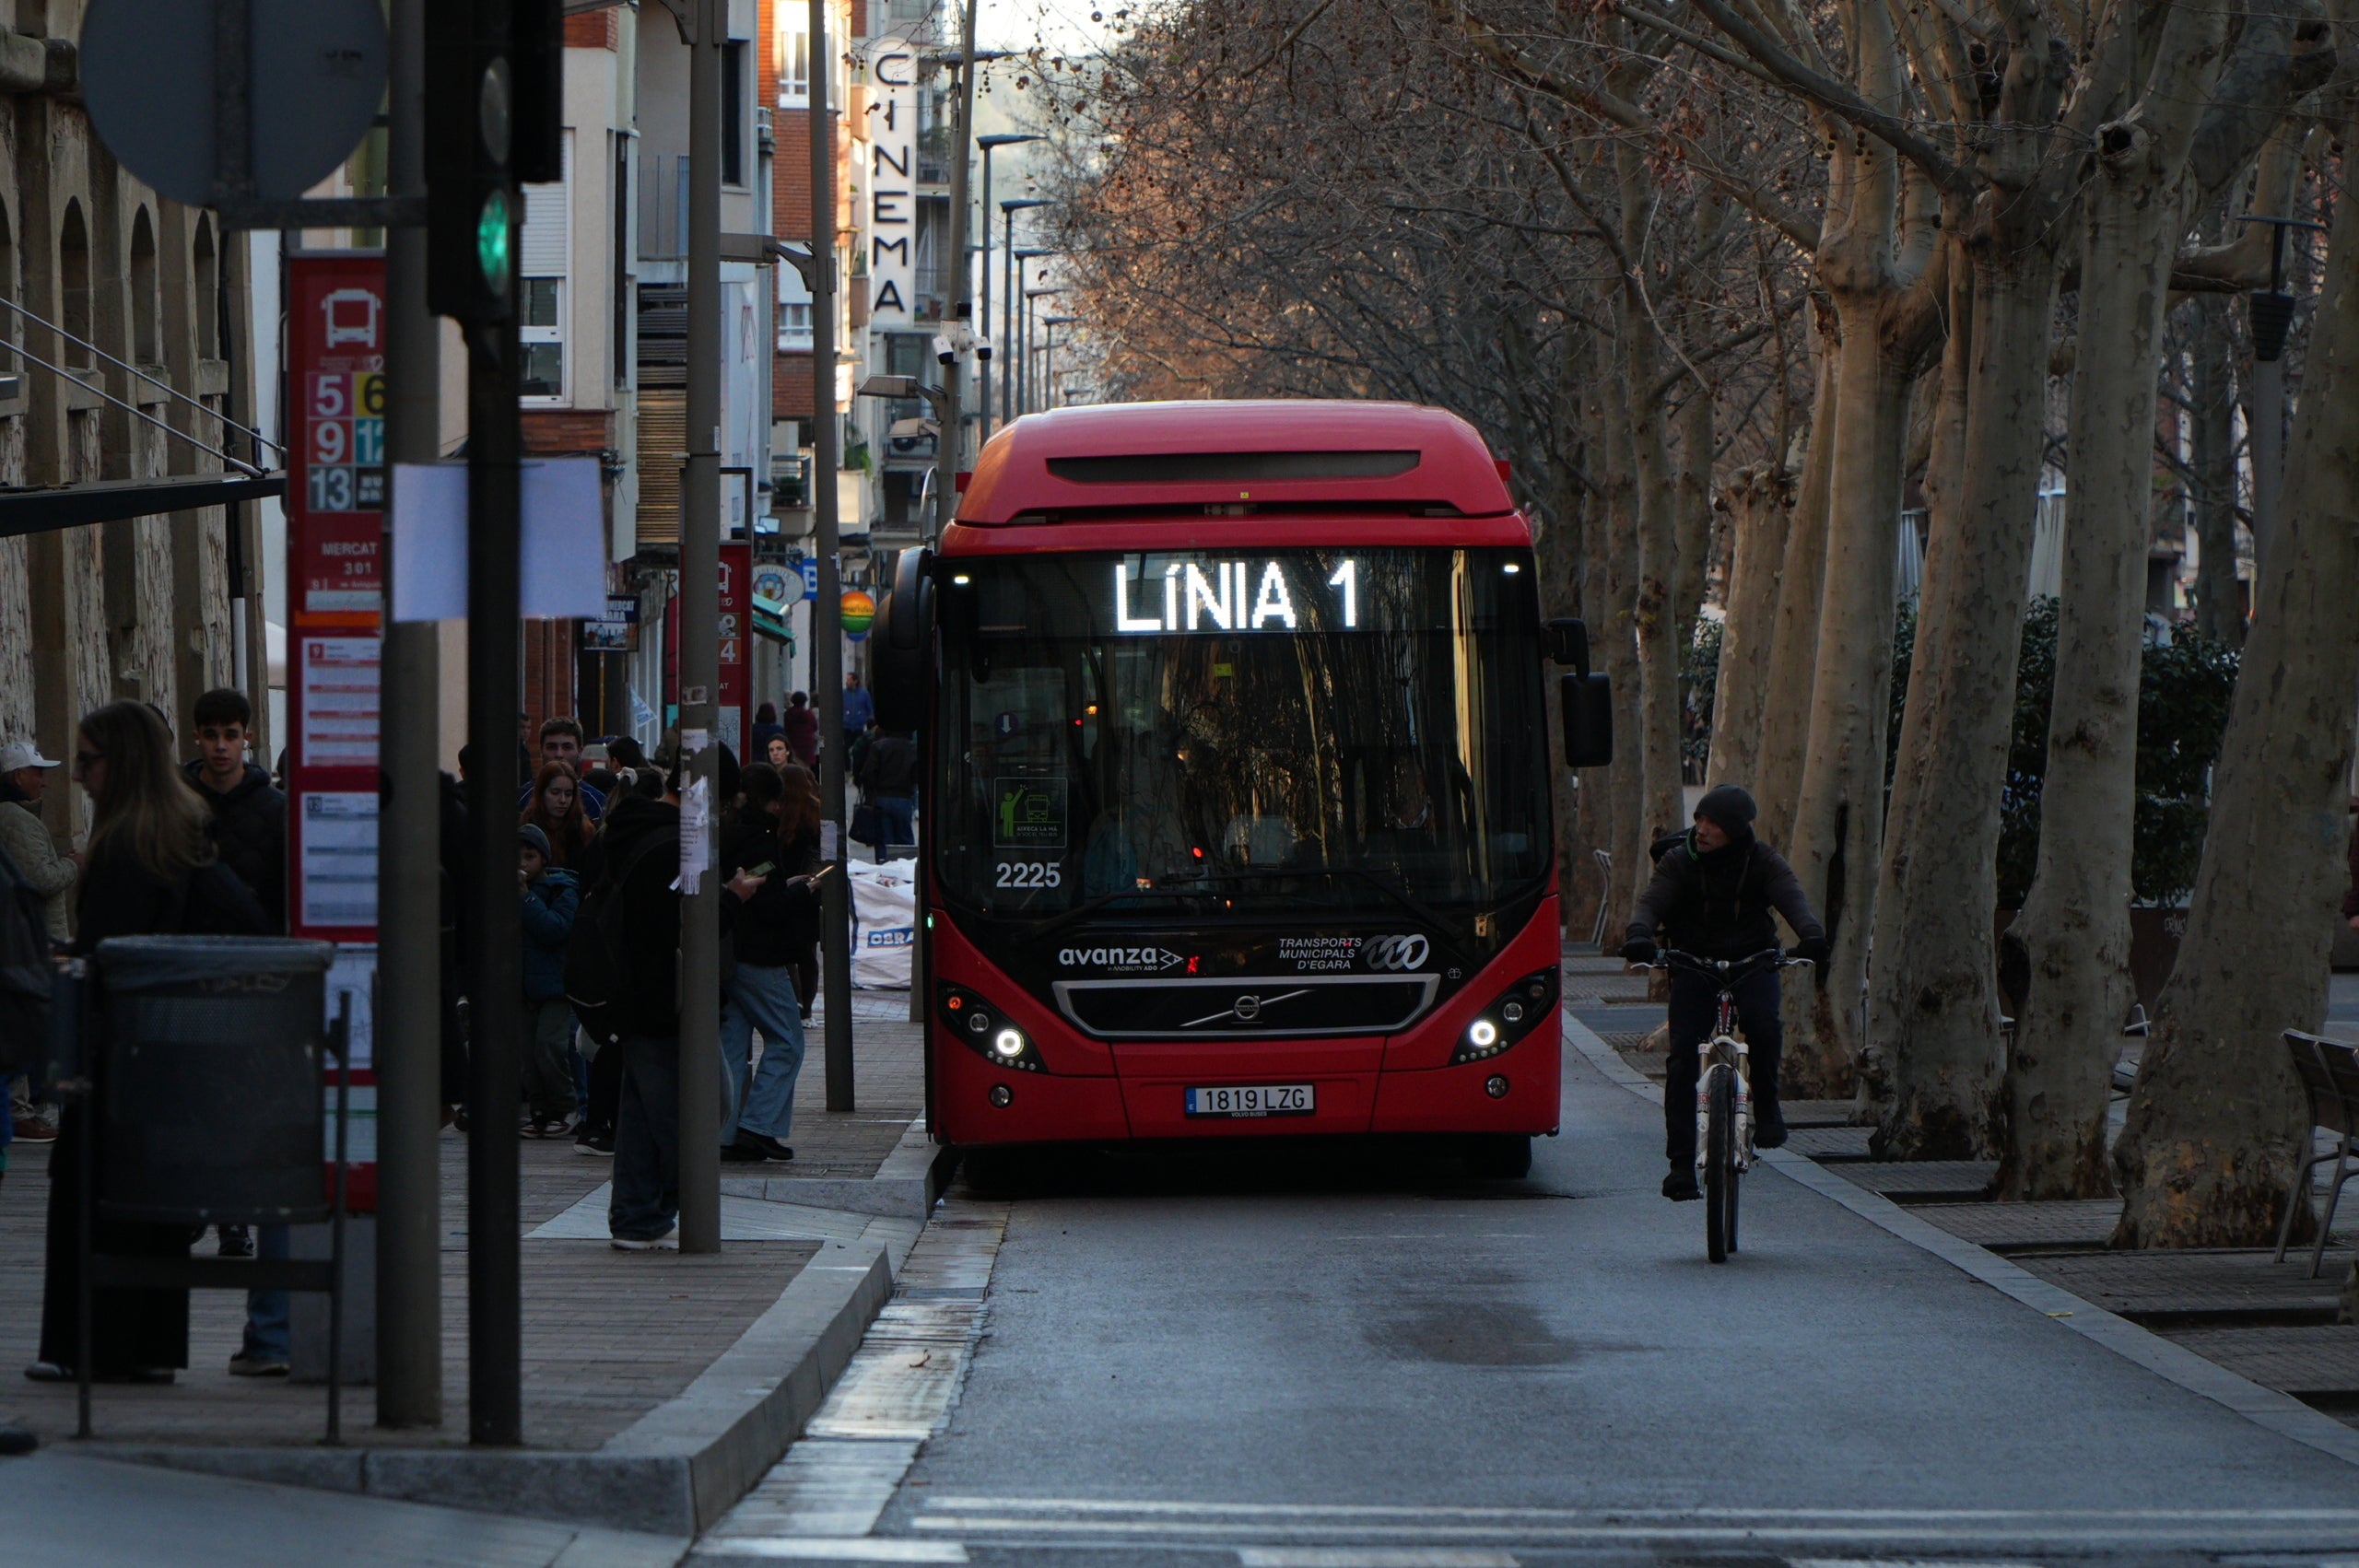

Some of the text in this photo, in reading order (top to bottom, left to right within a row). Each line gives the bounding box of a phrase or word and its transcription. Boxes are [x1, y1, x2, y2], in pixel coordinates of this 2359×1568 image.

[874, 53, 909, 313] CINEMA
[317, 374, 385, 416] 5 6
[316, 421, 346, 463] 9
[311, 467, 350, 510] 13
[321, 542, 378, 556] MERCAT
[343, 561, 371, 575] 301
[1329, 559, 1366, 627] 1
[720, 640, 736, 662] 4
[996, 861, 1062, 888] 2225
[1279, 938, 1362, 948] TRANSPORTS
[1279, 949, 1356, 959] MUNICIPALS
[1058, 947, 1157, 965] avanza
[1297, 960, 1351, 970] D'EGARA
[1206, 1089, 1304, 1111] 1819 LZG
